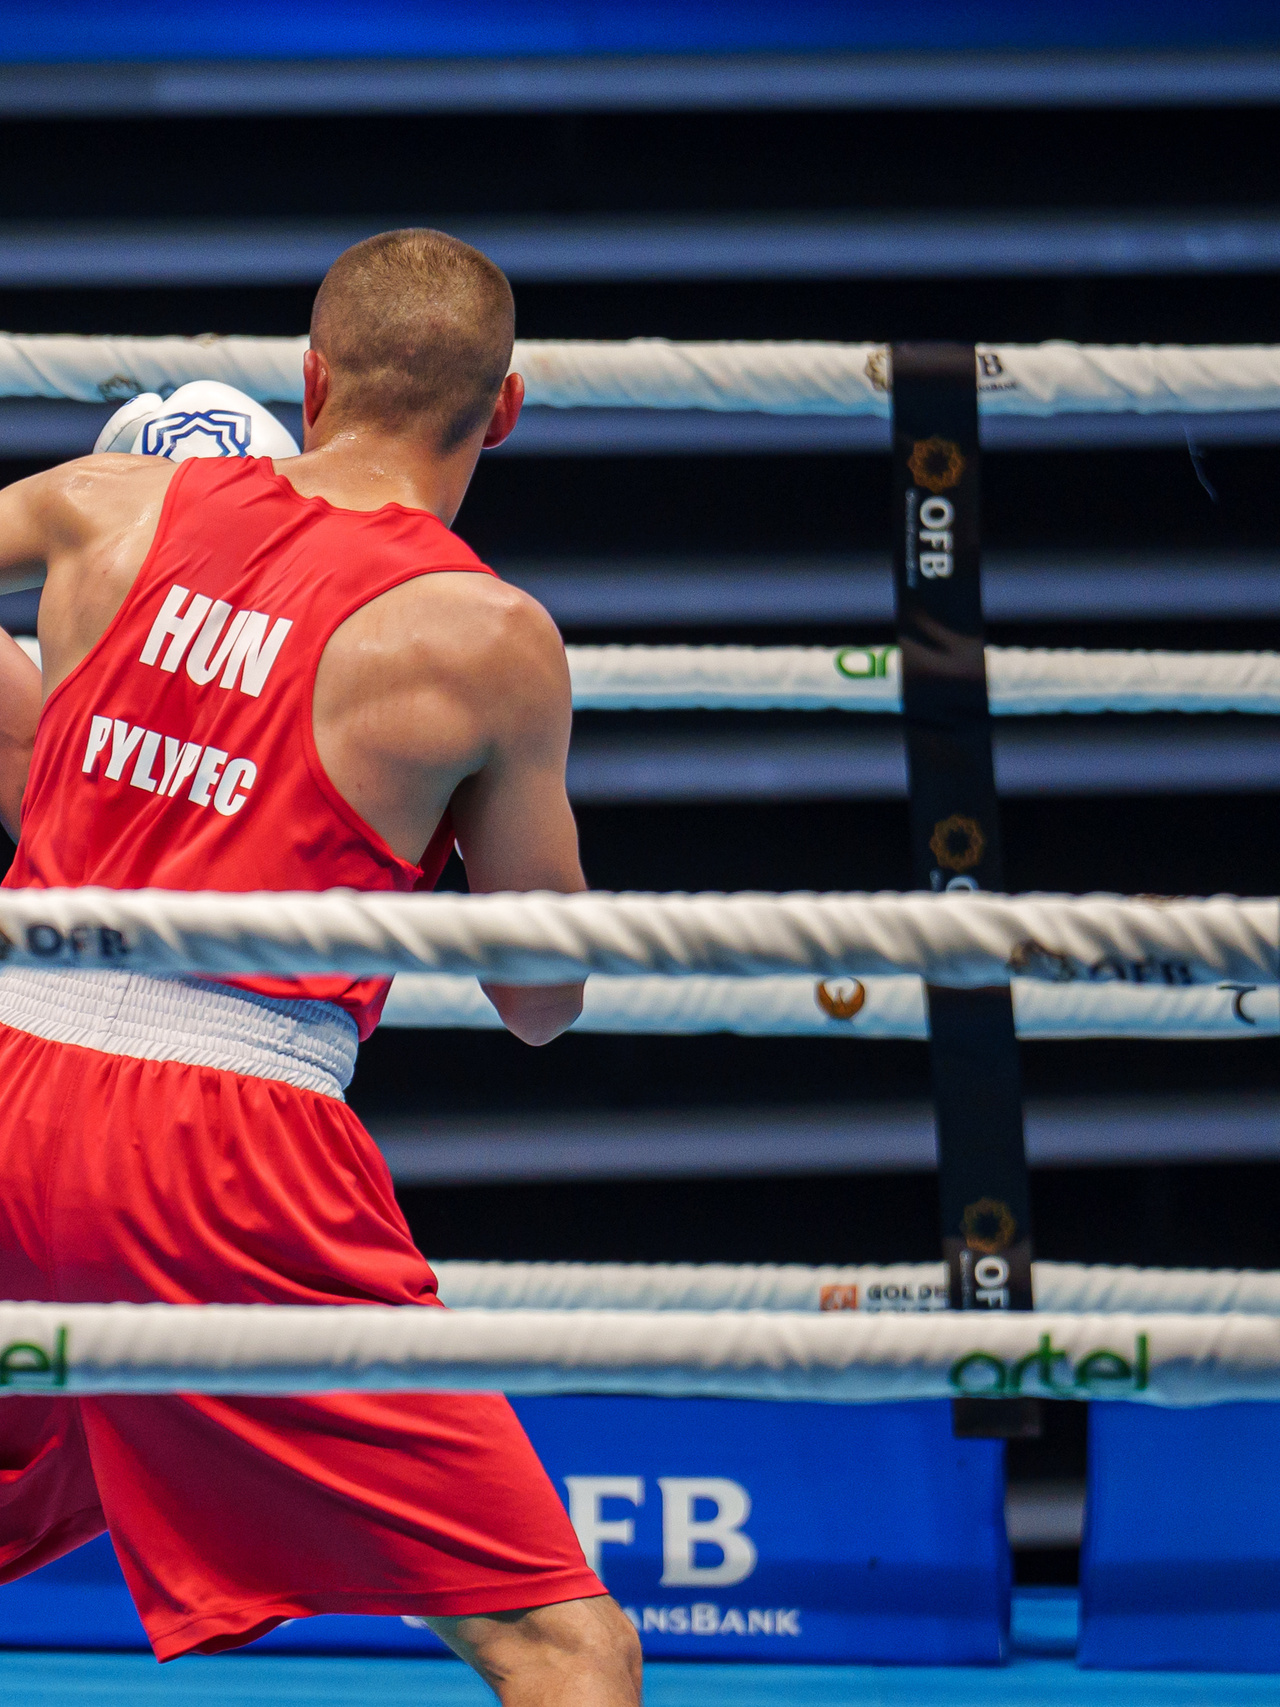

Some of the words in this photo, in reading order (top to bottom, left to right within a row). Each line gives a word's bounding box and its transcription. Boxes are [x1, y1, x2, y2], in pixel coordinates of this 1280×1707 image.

[919, 496, 954, 579] OFB
[139, 584, 294, 698] HUN
[81, 714, 258, 817] PYLYPEC
[975, 1256, 1010, 1309] OF
[949, 1332, 1148, 1393] artel
[563, 1475, 758, 1588] FB
[624, 1602, 801, 1637] ANSBANK
